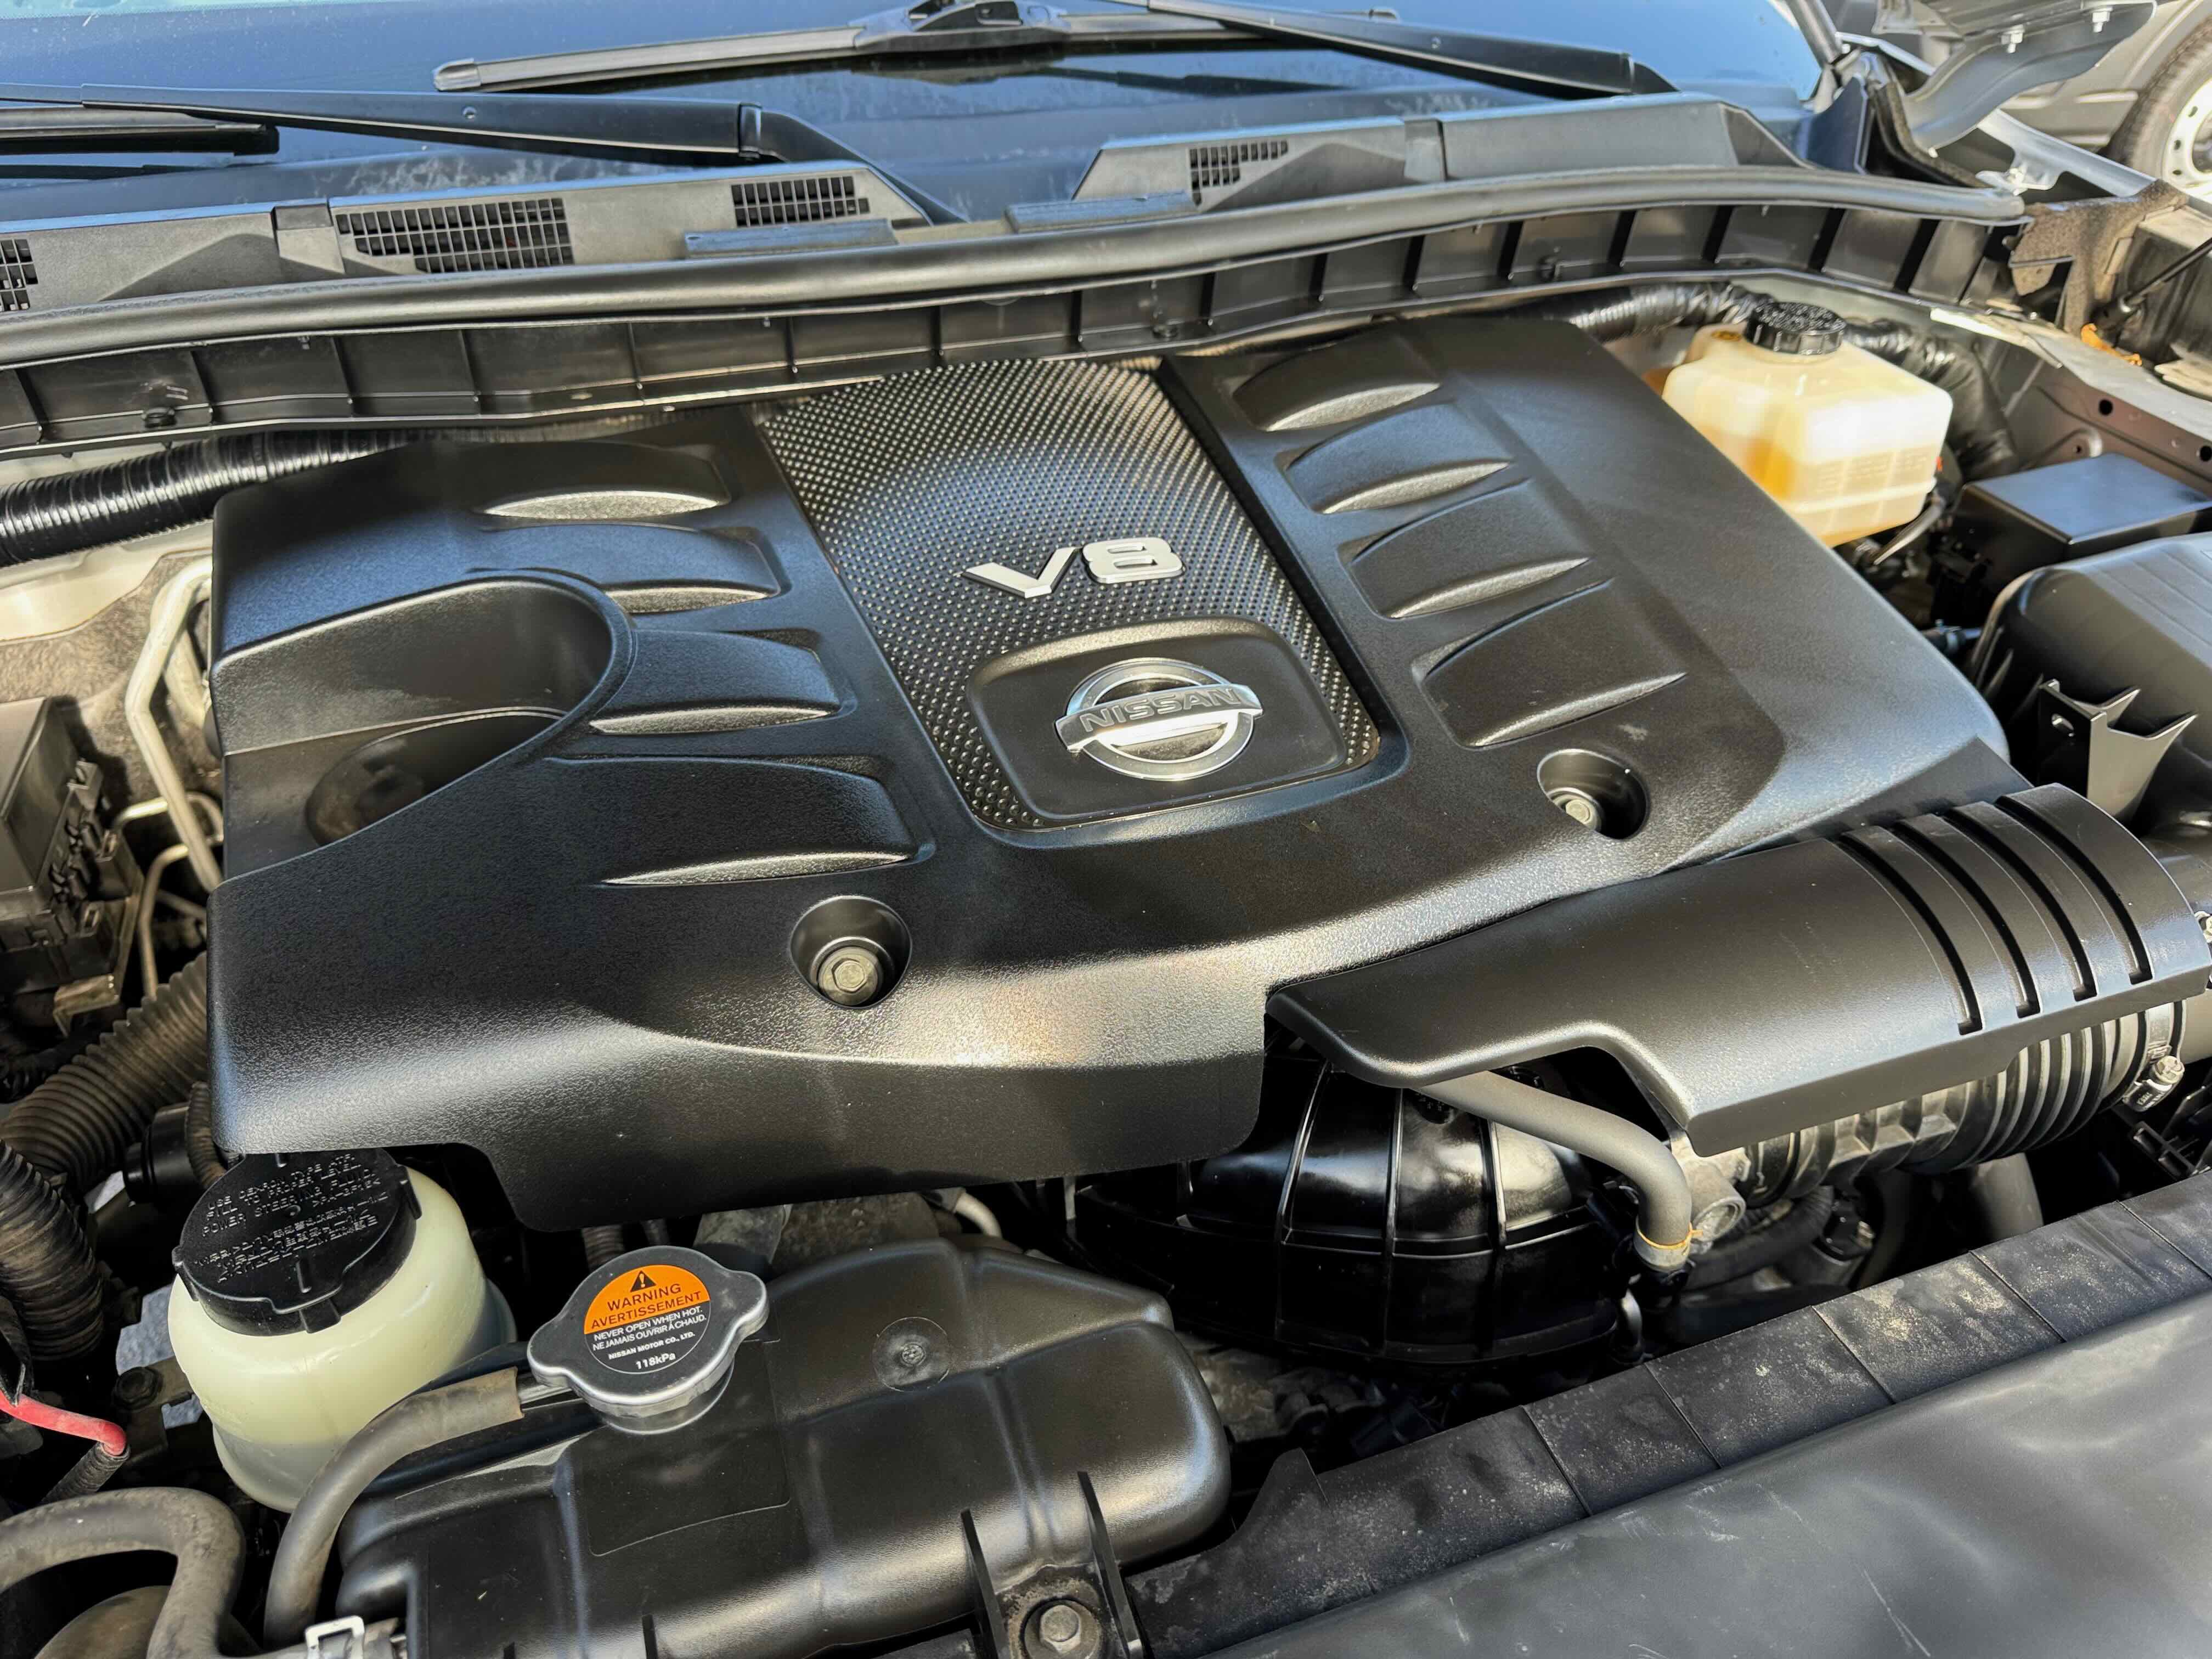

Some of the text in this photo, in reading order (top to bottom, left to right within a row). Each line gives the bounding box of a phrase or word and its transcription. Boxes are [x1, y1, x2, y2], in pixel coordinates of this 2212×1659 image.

[960, 537, 1186, 599] V8
[1079, 687, 1242, 733] NISSAN
[206, 1205, 238, 1221] FILL
[244, 1195, 260, 1206] TO
[268, 1176, 314, 1199] PROPER
[208, 1195, 232, 1210] USE
[290, 1163, 323, 1180] TYPE
[201, 1213, 246, 1237] POWER
[254, 1186, 323, 1217] STEERING
[591, 1291, 701, 1329] AVERTISSEMENT
[607, 1283, 681, 1311] WARNING
[592, 1341, 605, 1351] NE
[605, 1334, 635, 1348] JAMAIS
[636, 1326, 668, 1340] OUVRIR
[675, 1314, 707, 1328] CHAUD.
[594, 1306, 703, 1341] NEVER OPEN WHEN HOT.
[608, 1347, 636, 1360] NISSAN
[637, 1339, 664, 1353] MOTOR
[680, 1331, 695, 1340] LTD.
[636, 1352, 676, 1369] 118kPa
